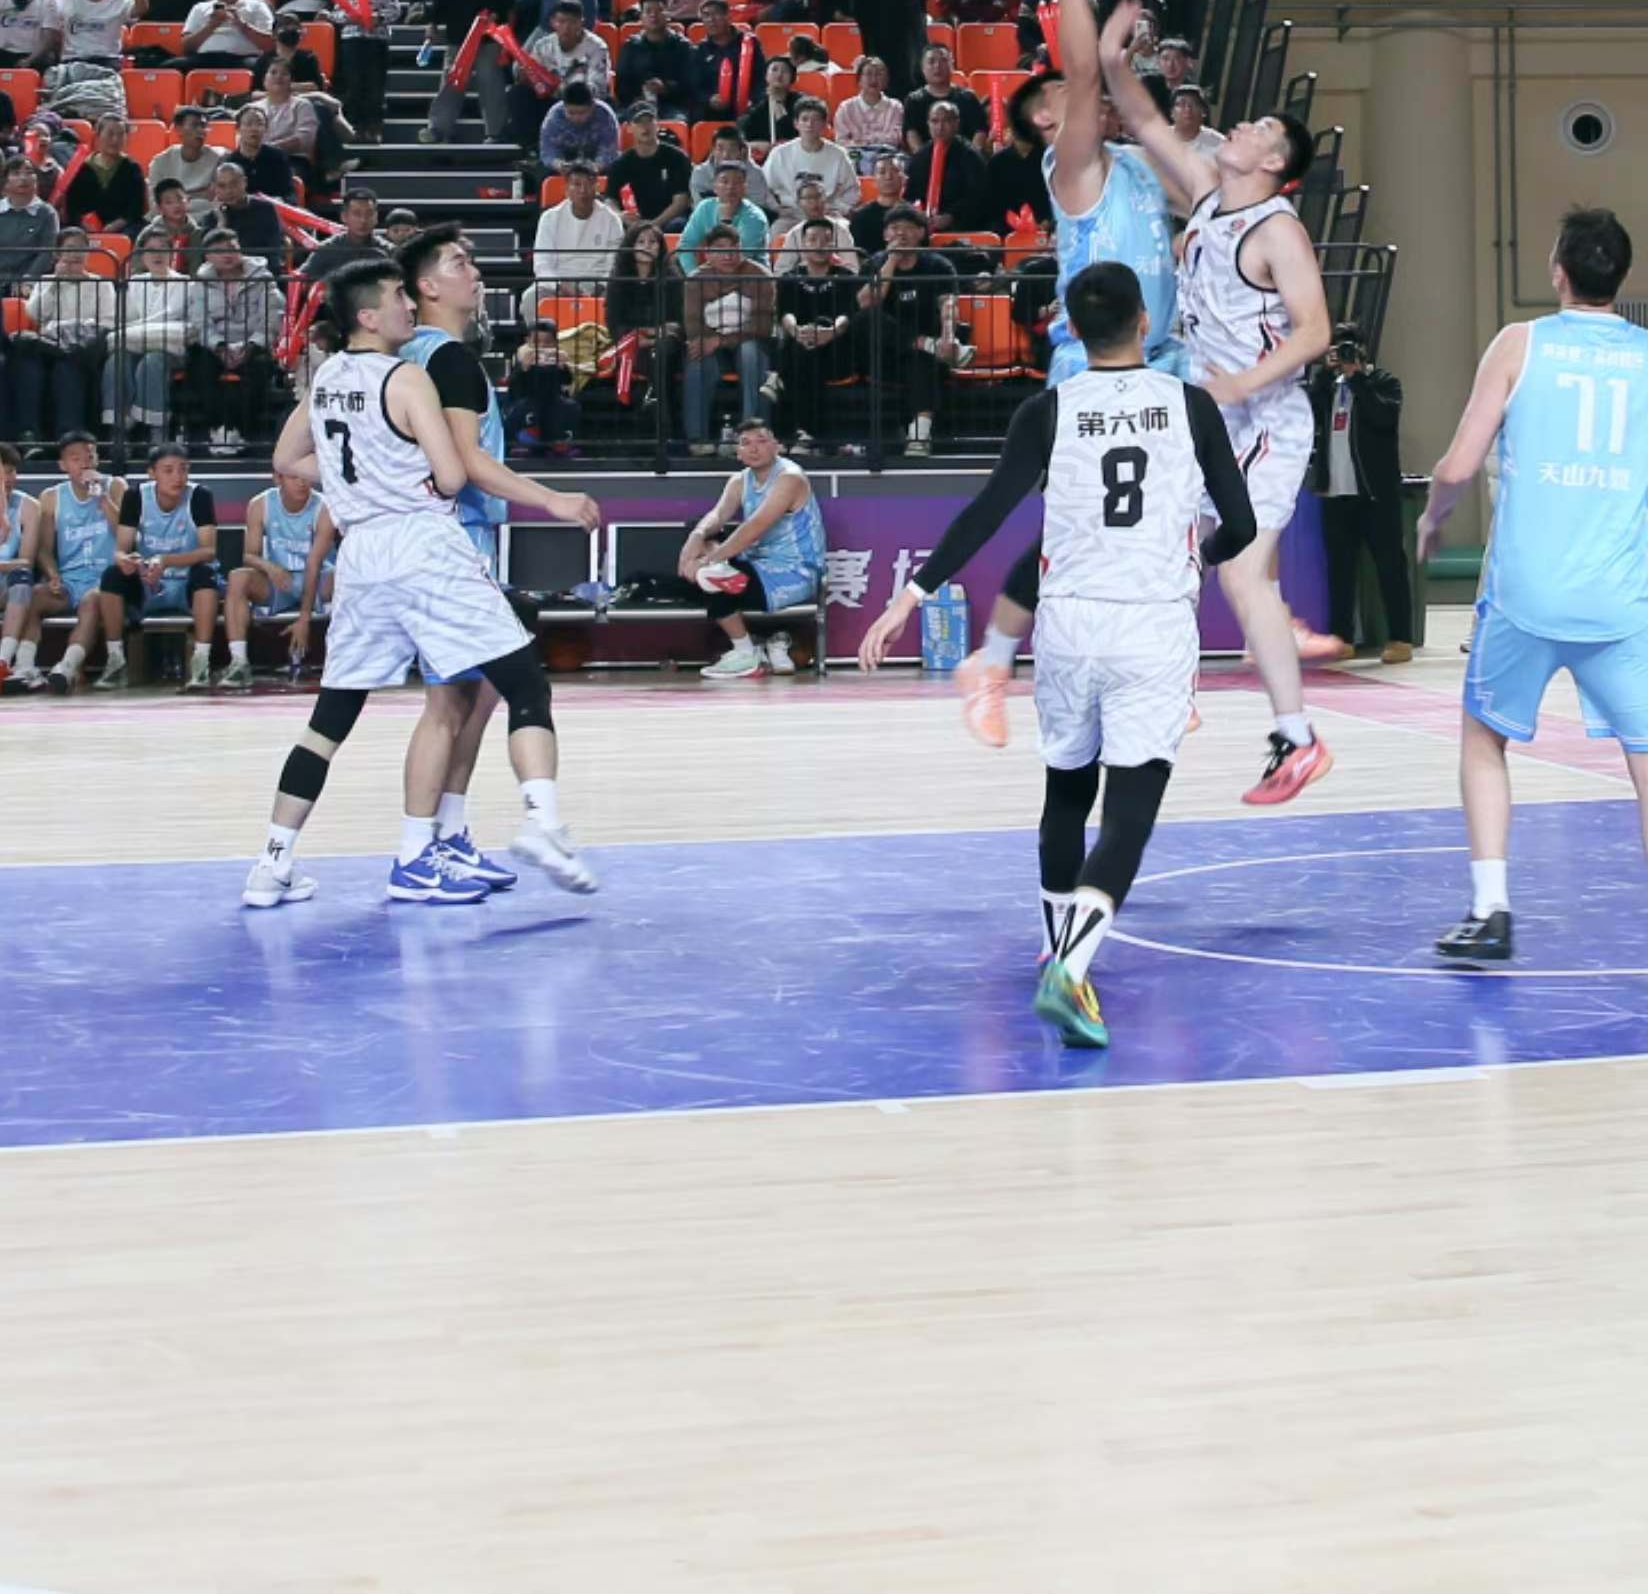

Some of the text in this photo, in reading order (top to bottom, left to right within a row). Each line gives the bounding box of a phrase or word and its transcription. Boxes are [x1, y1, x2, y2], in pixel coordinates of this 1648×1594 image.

[1076, 405, 1169, 438] 第六师
[1556, 372, 1631, 455] 71
[324, 418, 359, 485] 7
[1101, 444, 1150, 528] 8
